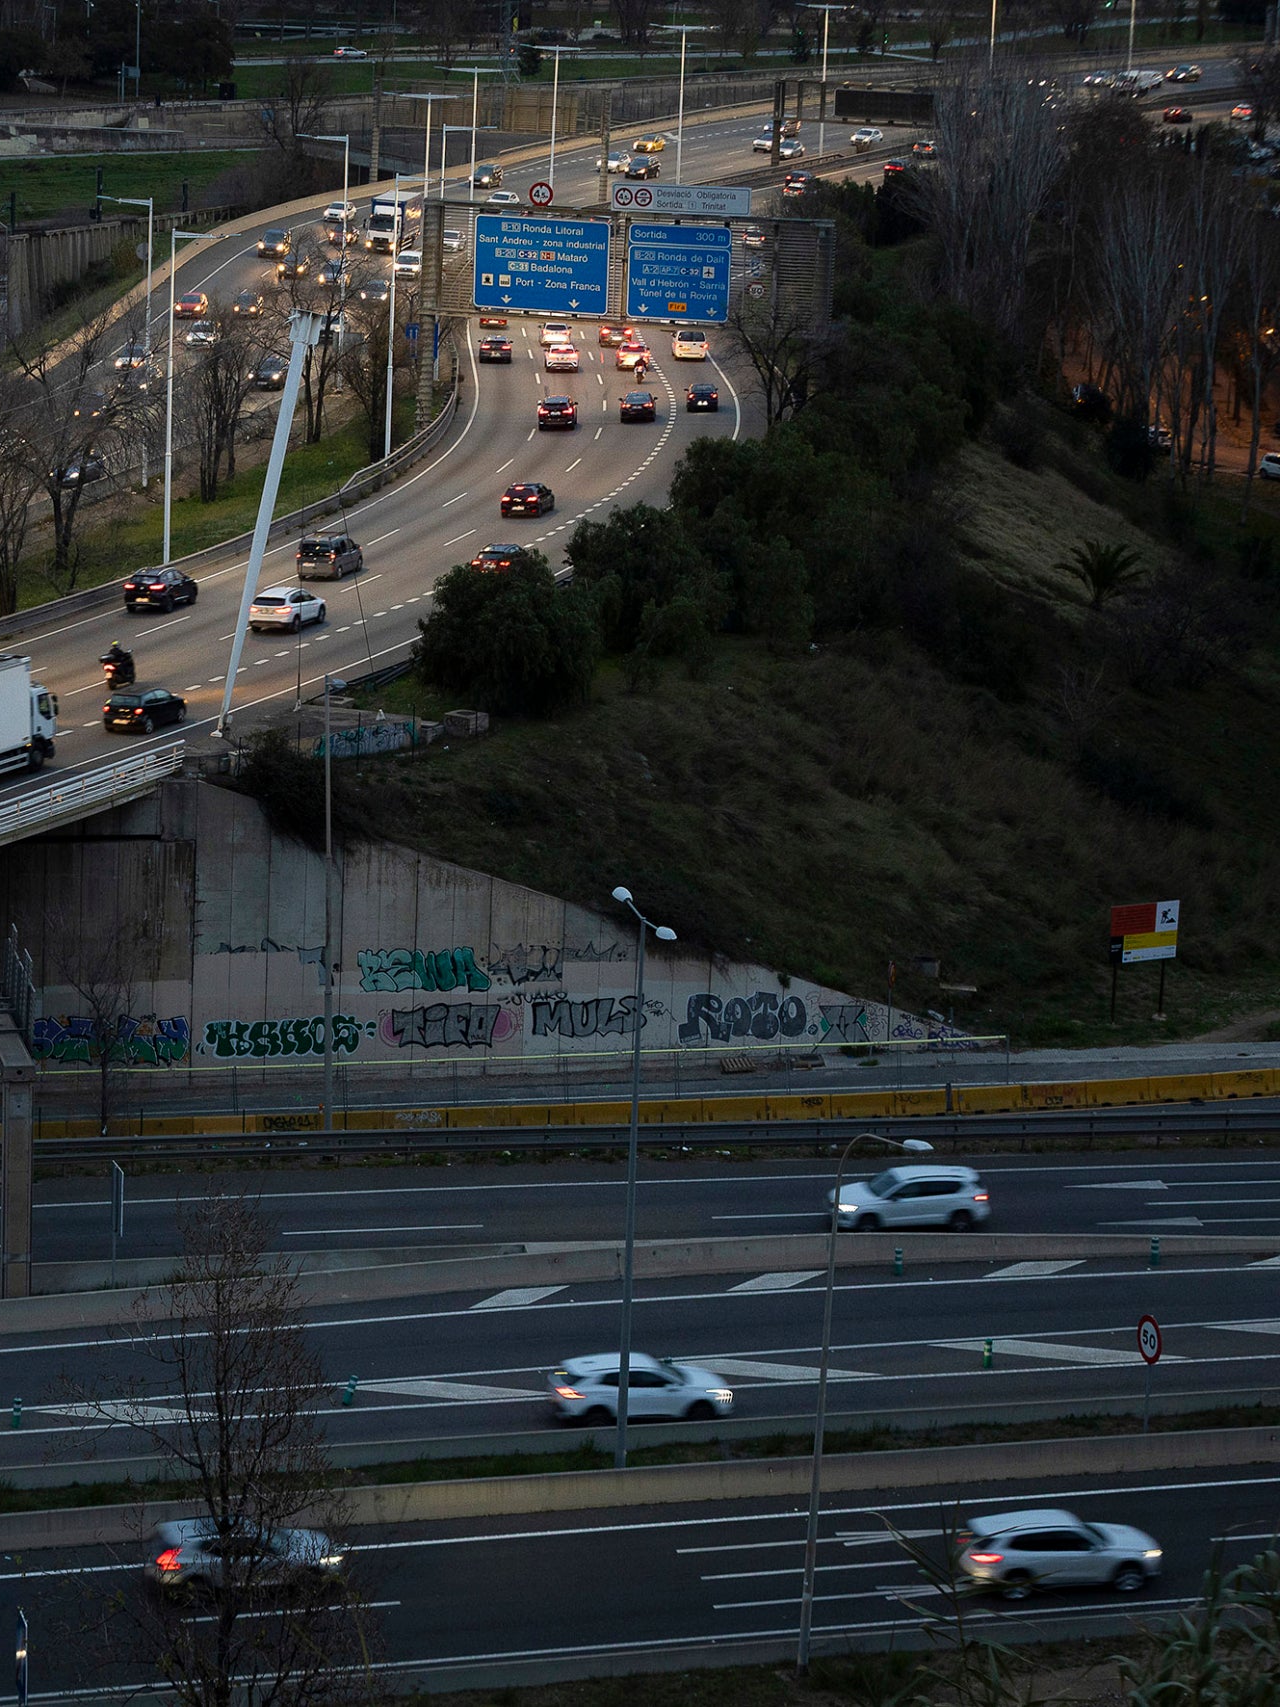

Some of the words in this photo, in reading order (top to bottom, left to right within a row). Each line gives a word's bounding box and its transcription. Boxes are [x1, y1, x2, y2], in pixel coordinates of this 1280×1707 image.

[657, 189, 692, 199] Desviació
[657, 200, 683, 209] Sortida
[702, 202, 726, 210] Trinitat
[522, 224, 552, 234] Ronda
[555, 225, 584, 236] Litoral
[634, 229, 668, 240] Sortida
[695, 232, 715, 242] 300
[479, 234, 499, 244] Sant
[502, 236, 533, 246] Andreu
[543, 240, 563, 248] zona
[566, 239, 606, 250] industrial
[518, 249, 537, 259] C-32
[557, 252, 589, 263] Mataró
[657, 251, 687, 262] Ronda
[690, 254, 703, 263] de
[706, 254, 725, 264] Dalt
[530, 263, 573, 274] Badalona
[643, 265, 659, 274] A-2
[680, 267, 700, 276] C-32
[515, 277, 534, 287] Port
[545, 279, 567, 289] Zona
[570, 281, 601, 292] Franca
[632, 277, 647, 286] Vall
[650, 279, 689, 289] d'Hebrón
[639, 288, 662, 297] Túnel
[664, 290, 676, 299] de
[679, 290, 687, 299] la
[690, 291, 718, 301] Rovira
[669, 303, 686, 311] Fira
[1142, 1329, 1156, 1350] 50
